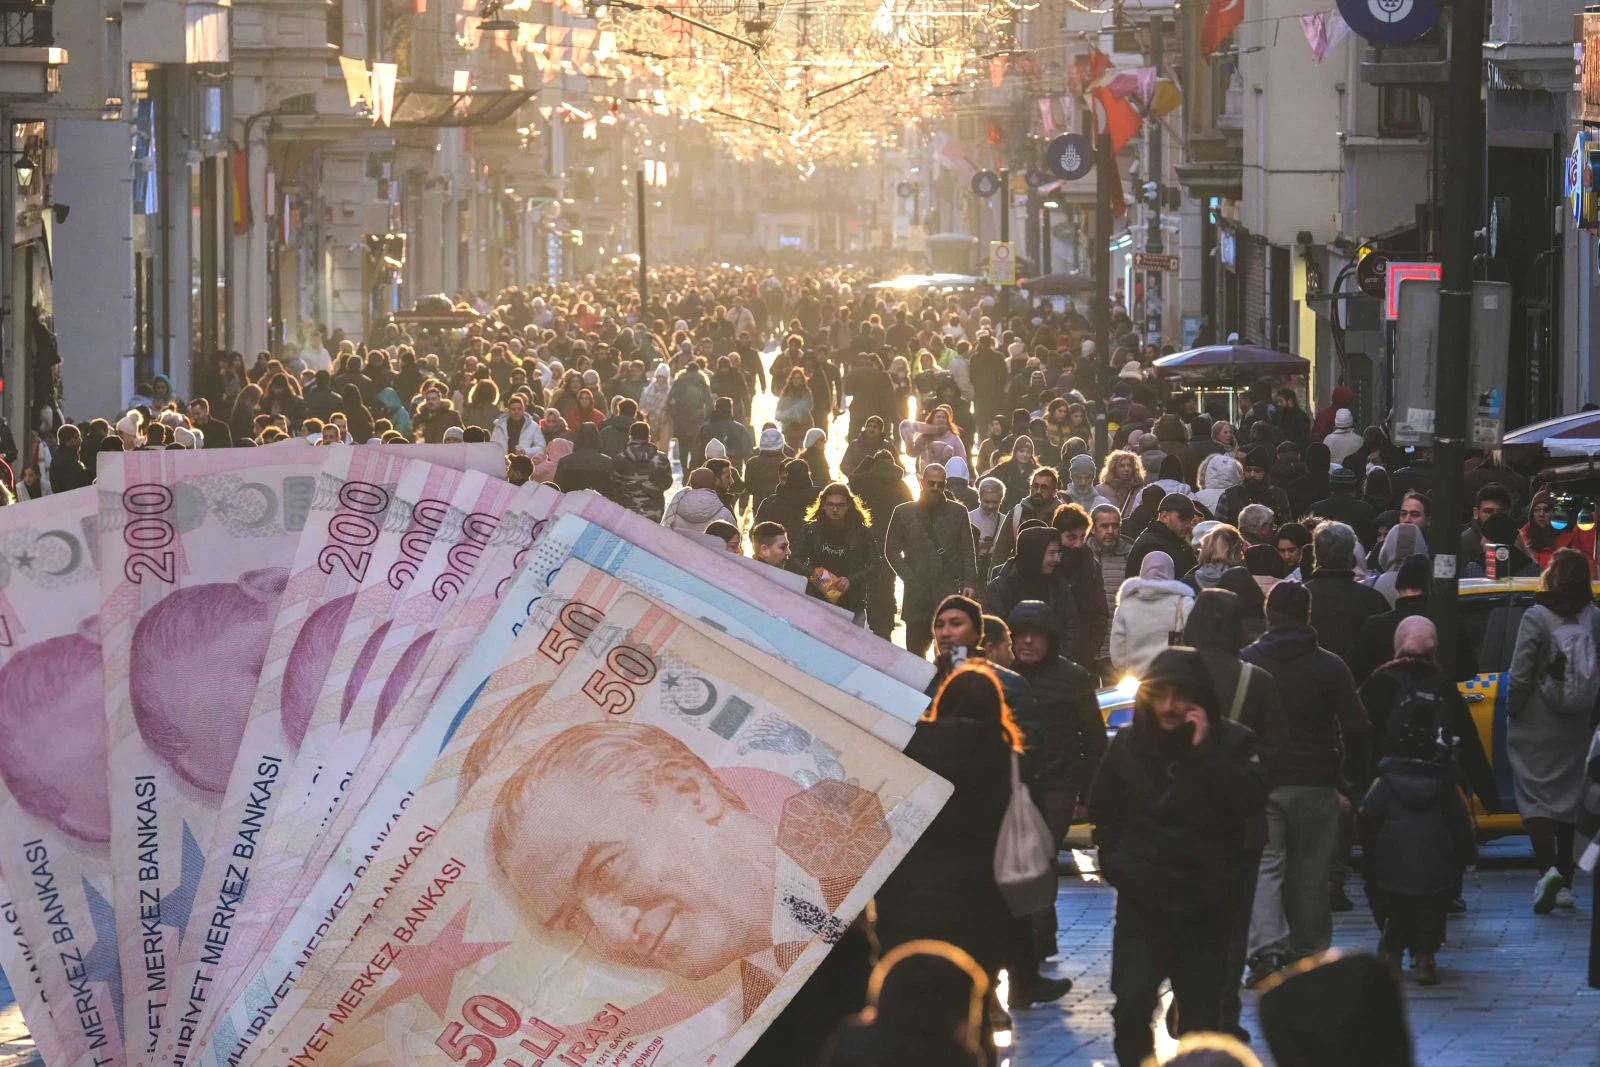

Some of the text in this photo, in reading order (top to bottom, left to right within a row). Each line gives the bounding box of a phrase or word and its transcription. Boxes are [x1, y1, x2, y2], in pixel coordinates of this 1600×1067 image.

[122, 483, 176, 584] 200
[317, 481, 390, 583] 200
[537, 602, 606, 665] 50
[581, 644, 658, 715] 50
[135, 775, 157, 881] BANKASI
[199, 863, 249, 966] MERKEZ
[233, 755, 283, 860] BANKASI
[23, 838, 75, 944] BANKASI
[139, 887, 168, 992] MERKEZ
[328, 941, 403, 1026] MERKEZ
[392, 856, 467, 944] BANKASI
[60, 947, 108, 1051] MERKEZ
[434, 994, 522, 1067] 50
[596, 1049, 611, 1067] 1211
